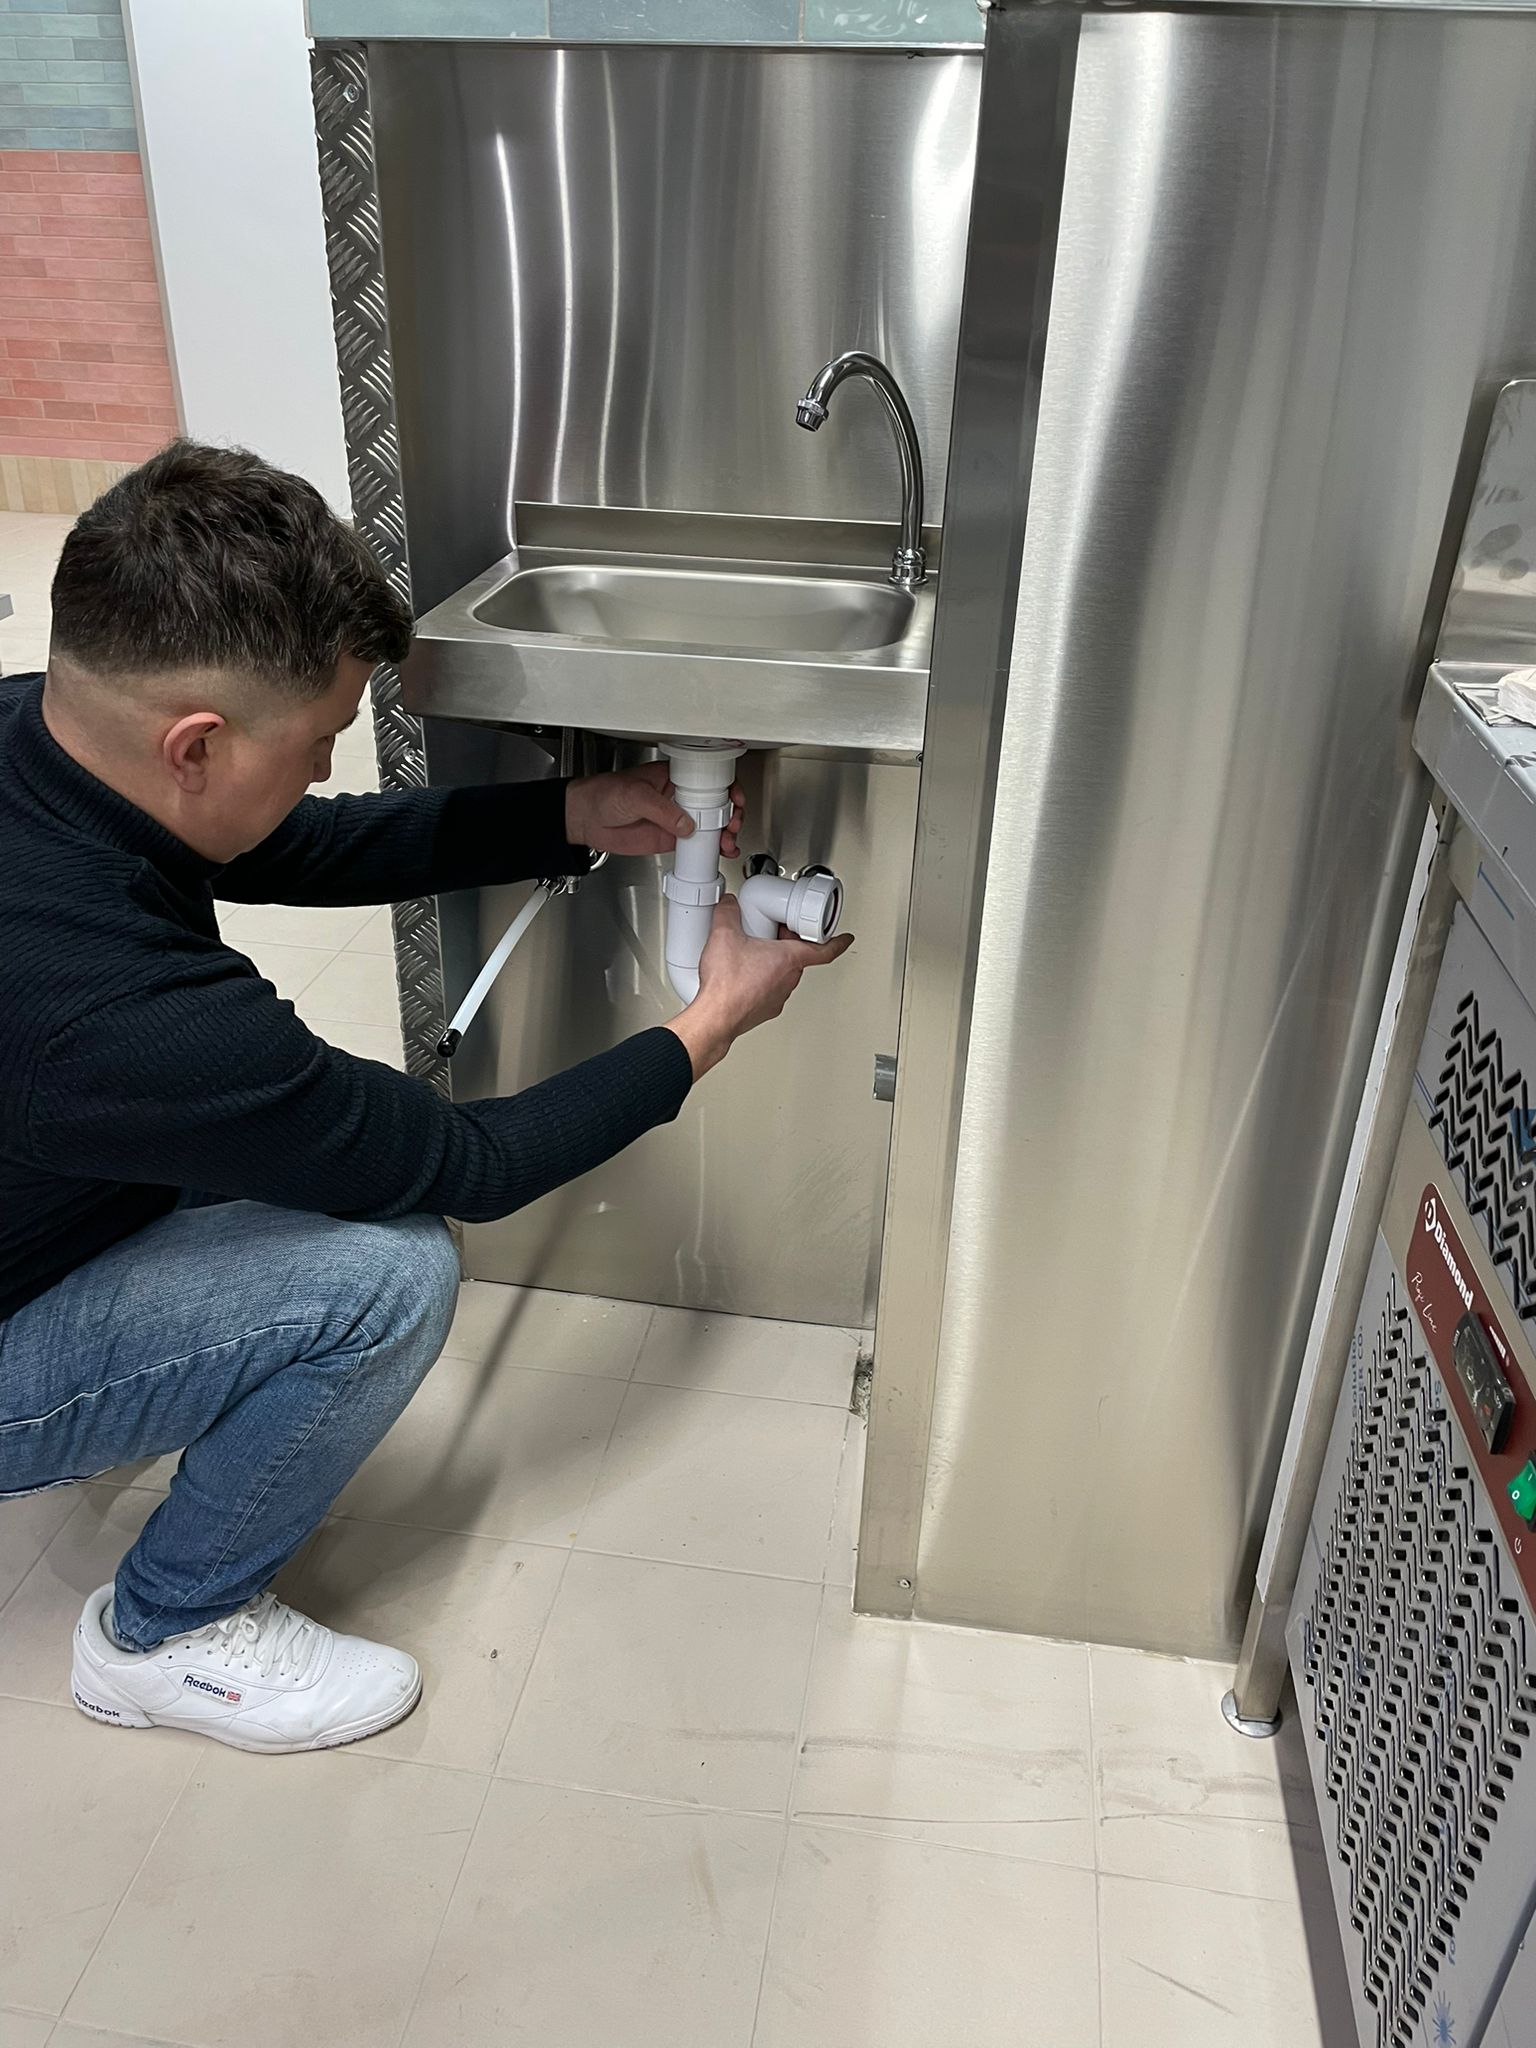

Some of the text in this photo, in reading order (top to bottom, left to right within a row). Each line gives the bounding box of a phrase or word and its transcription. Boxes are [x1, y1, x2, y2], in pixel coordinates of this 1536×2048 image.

[1434, 1220, 1474, 1311] Diamond
[183, 1674, 227, 1698] Reebok
[75, 1691, 121, 1718] Reebok
